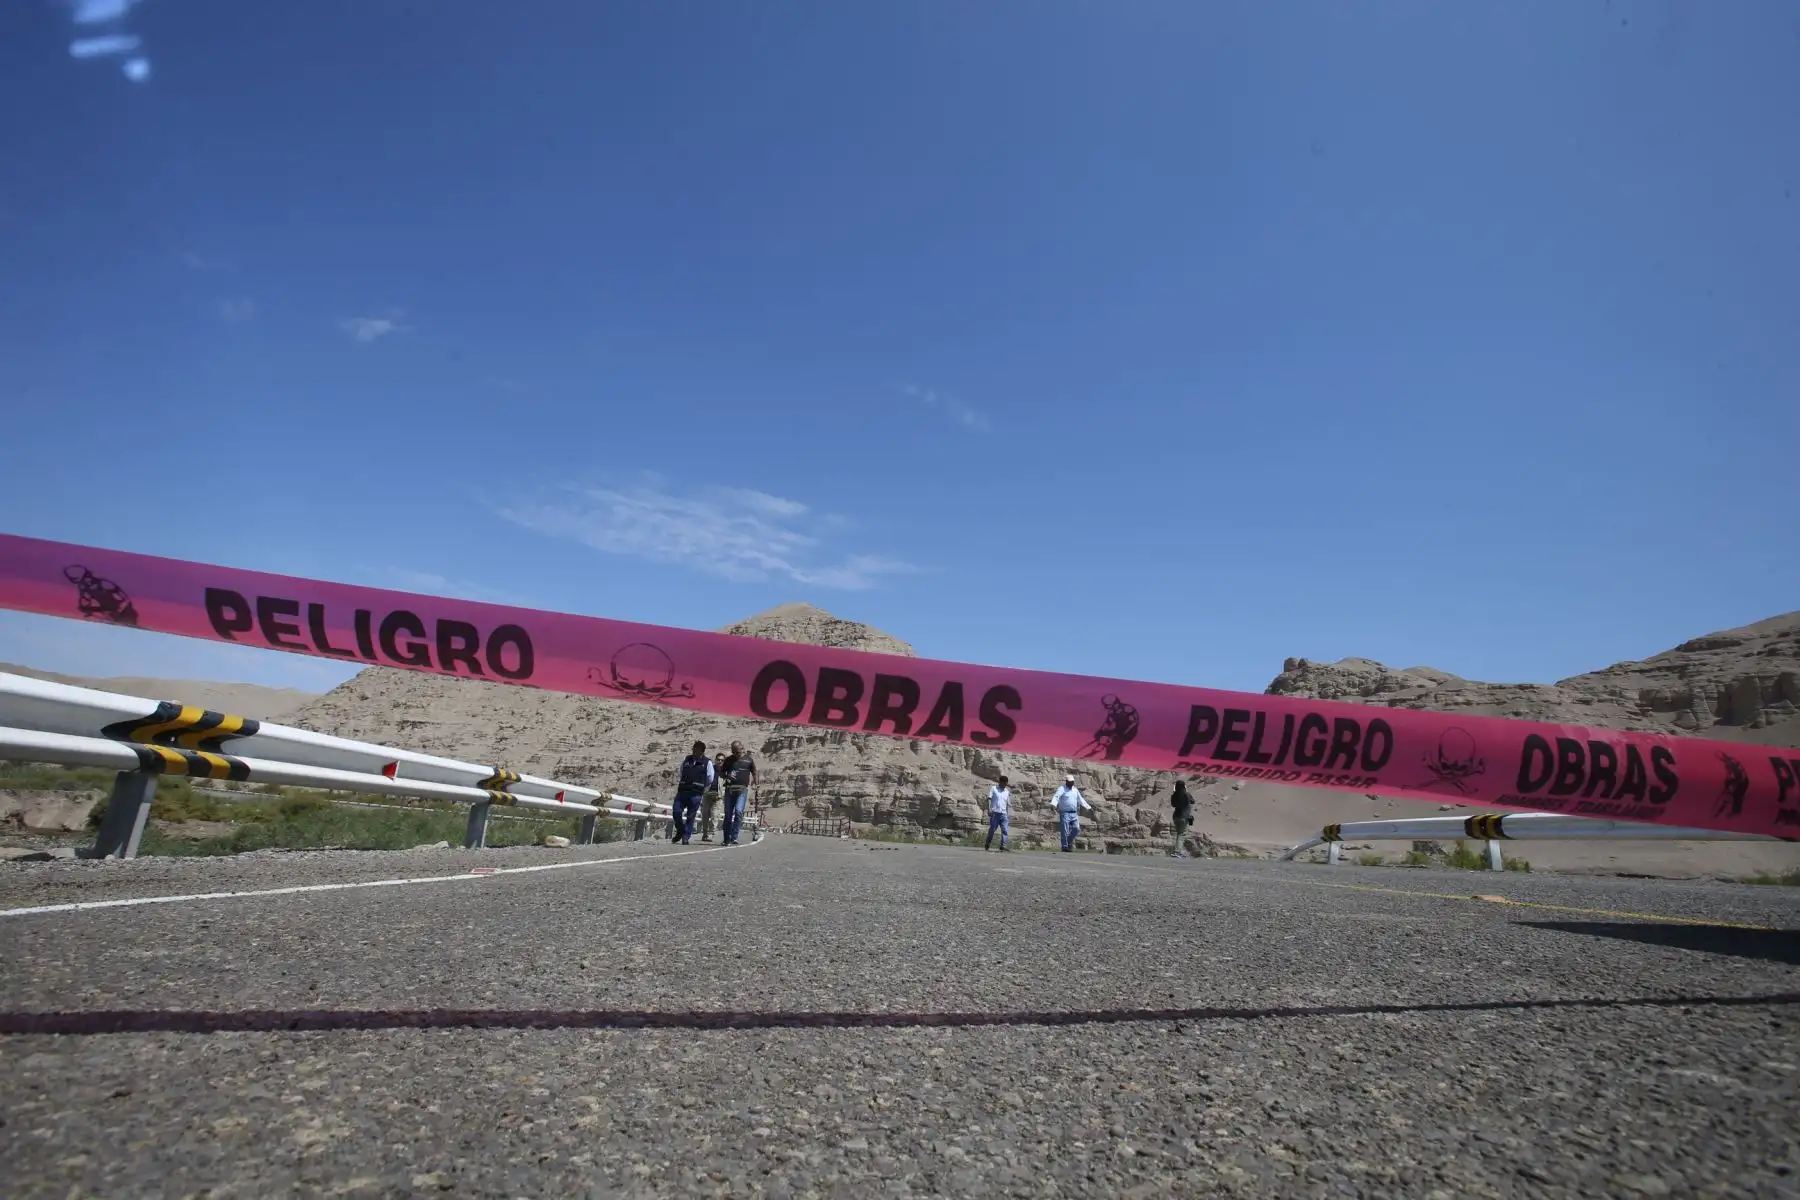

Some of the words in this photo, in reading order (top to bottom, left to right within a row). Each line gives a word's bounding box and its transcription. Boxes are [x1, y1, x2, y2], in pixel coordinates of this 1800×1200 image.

[205, 587, 534, 680] PELIGRO
[749, 659, 1022, 746] OBRAS
[1177, 704, 1394, 772] PELIGRO
[1516, 734, 1679, 804] OBRAS
[1171, 761, 1301, 782] PROHIBIDO
[1302, 772, 1380, 789] PASAR
